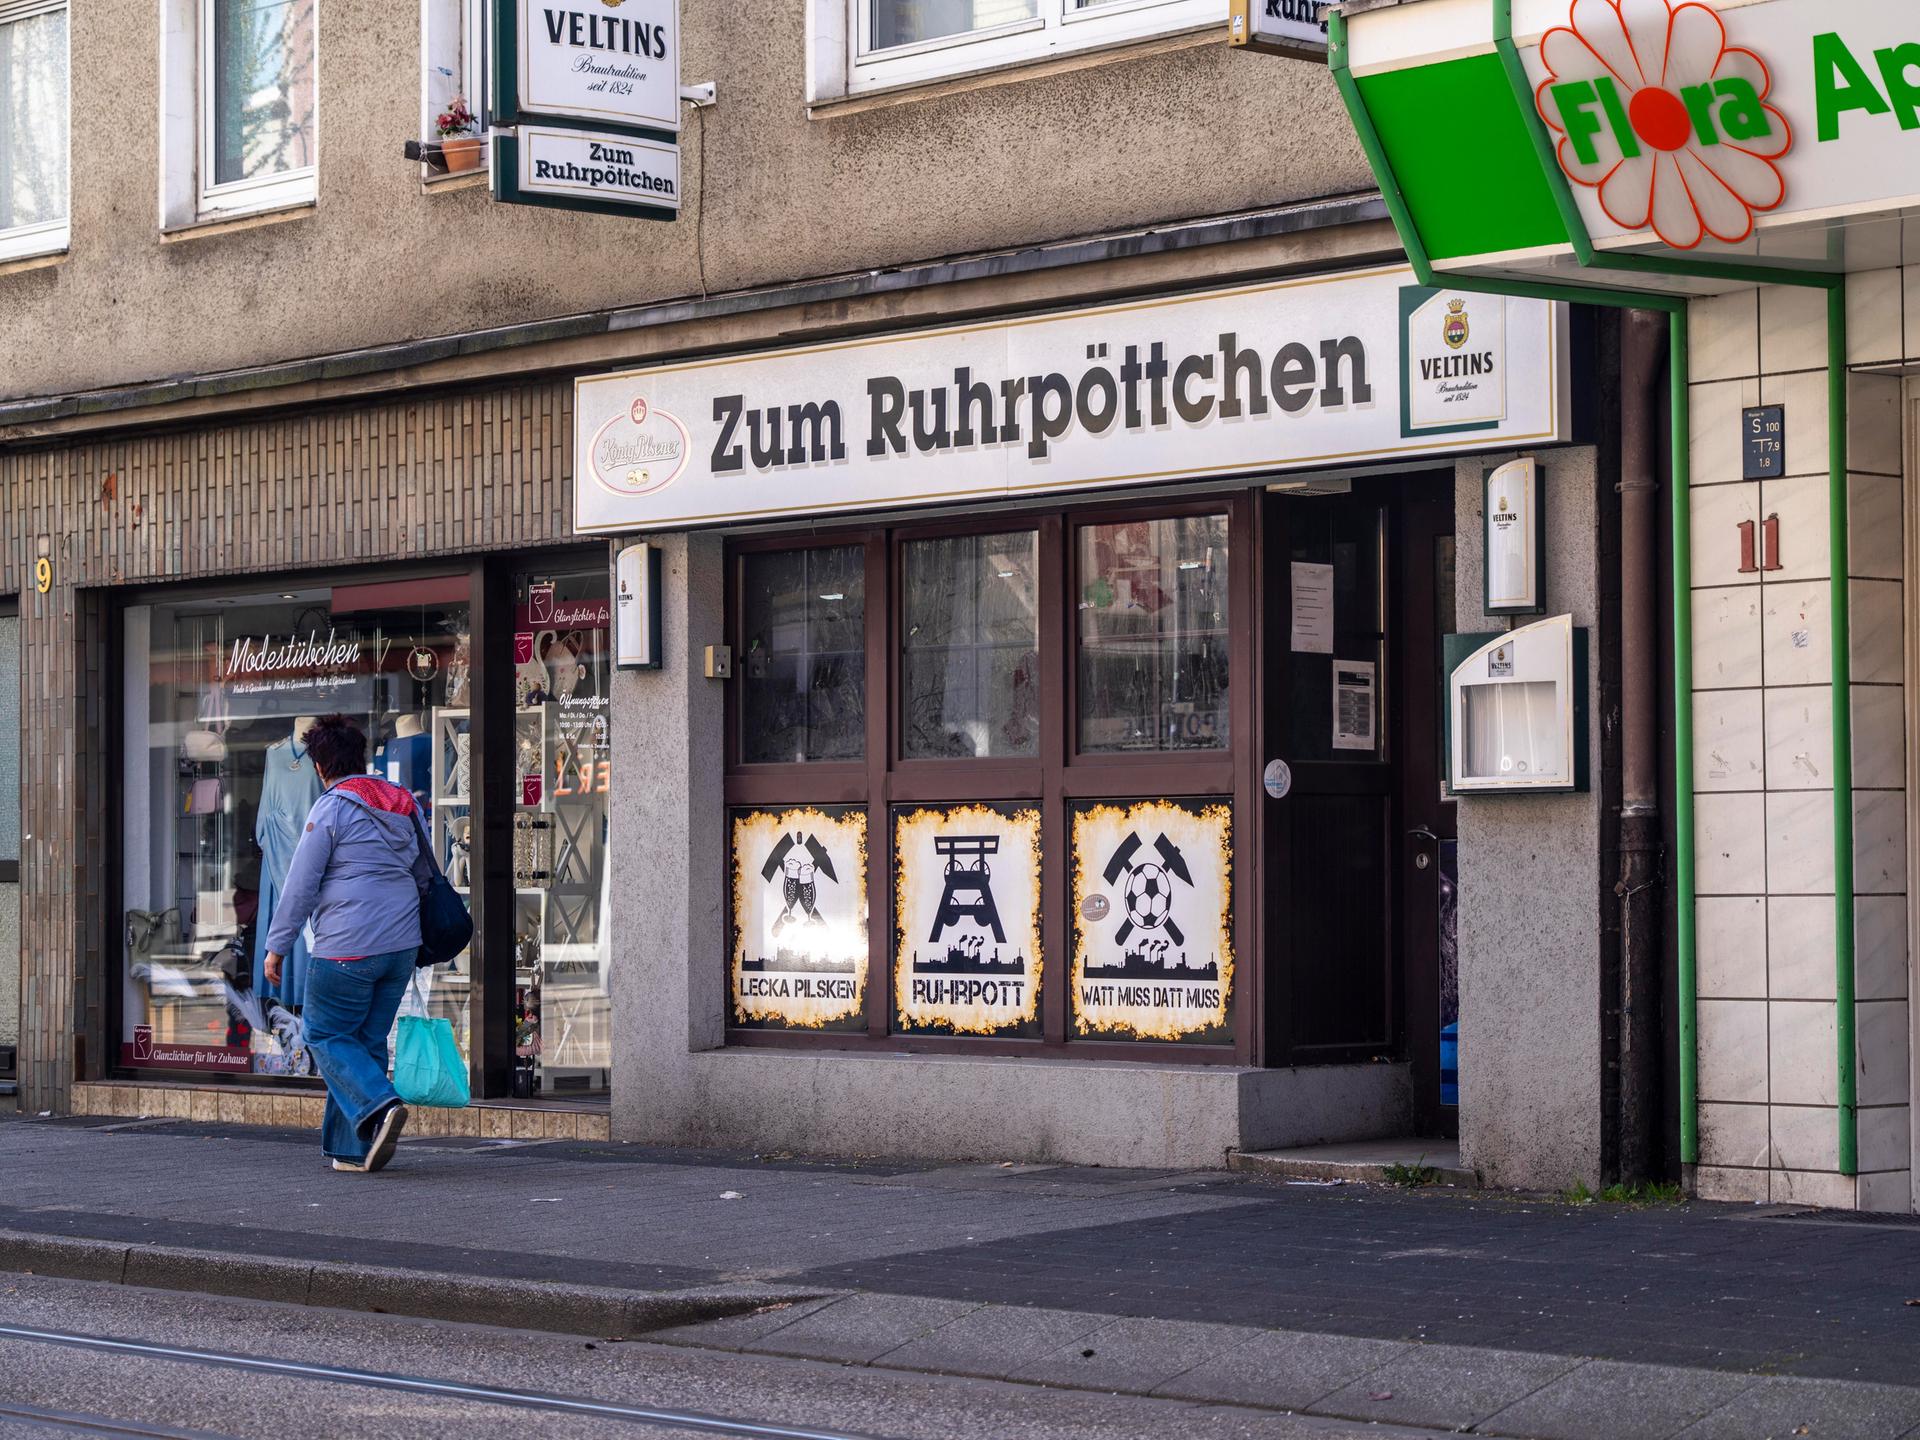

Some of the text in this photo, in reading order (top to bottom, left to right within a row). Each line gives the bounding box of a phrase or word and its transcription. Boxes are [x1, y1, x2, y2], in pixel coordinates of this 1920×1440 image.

[544, 8, 667, 60] VELTINS
[571, 53, 648, 81] Brautradition
[587, 80, 634, 95] seit 1824
[589, 142, 634, 166] Zum
[535, 159, 676, 195] Ruhrpöttchen
[1420, 351, 1494, 381] VELTINS
[710, 331, 1371, 472] Zum Ruhrpöttchen
[1752, 418, 1780, 433] S 100
[1492, 512, 1517, 522] VELTINS
[1737, 518, 1783, 573] 11
[36, 557, 52, 593] 9
[554, 608, 596, 625] Glanzlichter
[226, 627, 361, 676] Modestübchen
[740, 978, 856, 999] LECKA PILSKEN
[913, 979, 1024, 1006] RUHRPOTT
[1081, 985, 1220, 1008] WATT MUSS DATT MUSS
[153, 1049, 248, 1065] Glanzlichter für Ihr Zuhause
